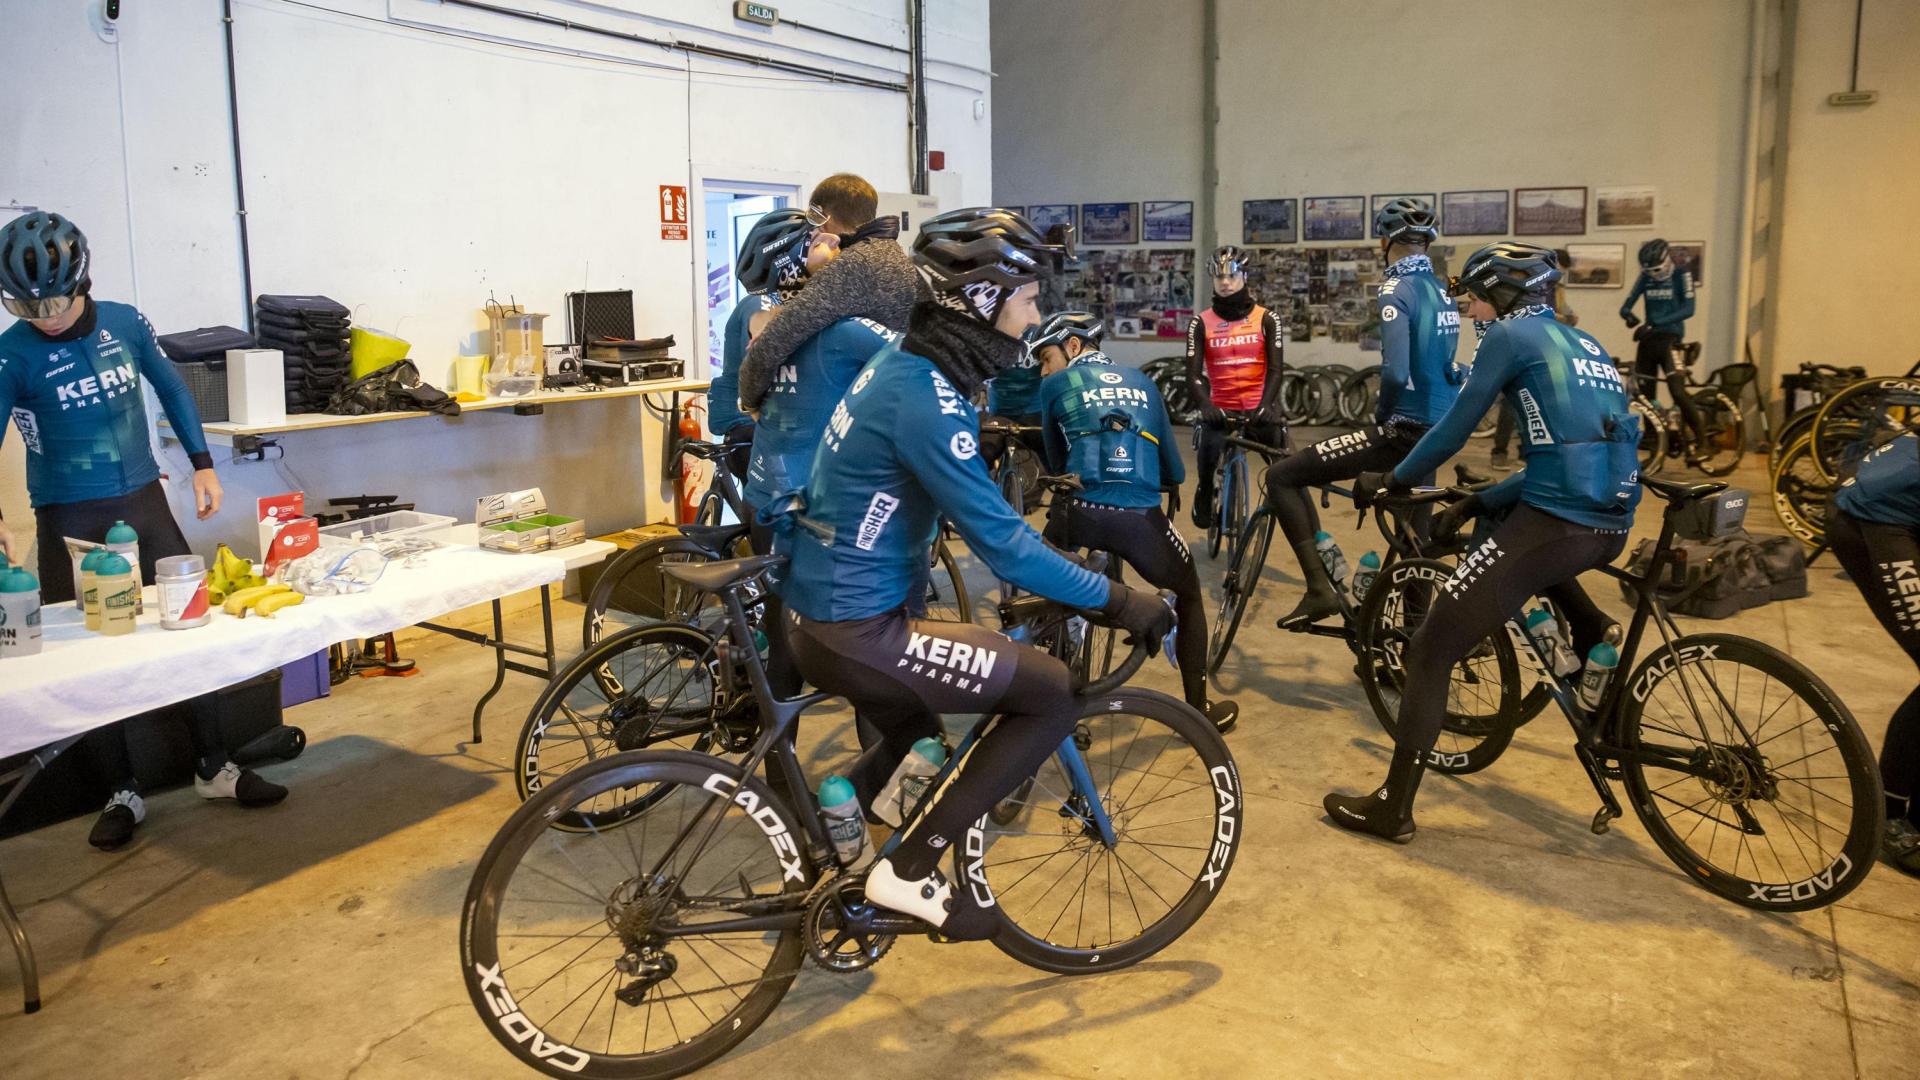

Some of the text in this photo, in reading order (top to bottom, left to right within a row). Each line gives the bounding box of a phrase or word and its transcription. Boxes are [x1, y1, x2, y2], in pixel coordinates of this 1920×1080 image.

[748, 5, 773, 20] SALIDA
[763, 237, 789, 254] GIANT
[774, 256, 791, 266] KERN
[1469, 259, 1493, 277] GIANT
[1525, 271, 1551, 287] GIANT
[851, 316, 898, 343] KER
[1190, 319, 1199, 350] LIZARTE
[1210, 334, 1259, 348] LIZARTE
[46, 362, 76, 379] GIANT
[56, 363, 135, 401] KERN
[1579, 379, 1623, 393] PHARM
[62, 382, 136, 411] PHARMA
[1082, 387, 1148, 402] KERN
[1085, 400, 1148, 409] PHARMA
[1521, 390, 1546, 441] FINISHER
[1315, 430, 1368, 455] KERN
[1321, 441, 1372, 462] PHARMA
[859, 498, 893, 547] FINISHER
[1392, 566, 1450, 585] CADE
[1444, 537, 1498, 593] KERN
[1452, 550, 1505, 600] PHARMA
[1879, 563, 1911, 631] PHARMA
[1892, 559, 1920, 631] KER
[905, 632, 997, 679] KERN
[897, 658, 982, 694] PHARMA
[1633, 644, 1720, 702] CADEX
[525, 717, 549, 797] ADEX
[702, 773, 805, 883] CADEX
[1200, 765, 1235, 892] CADEX
[966, 811, 996, 908] CADE
[1747, 852, 1853, 902] CADEX
[475, 962, 591, 1072] CADEX
